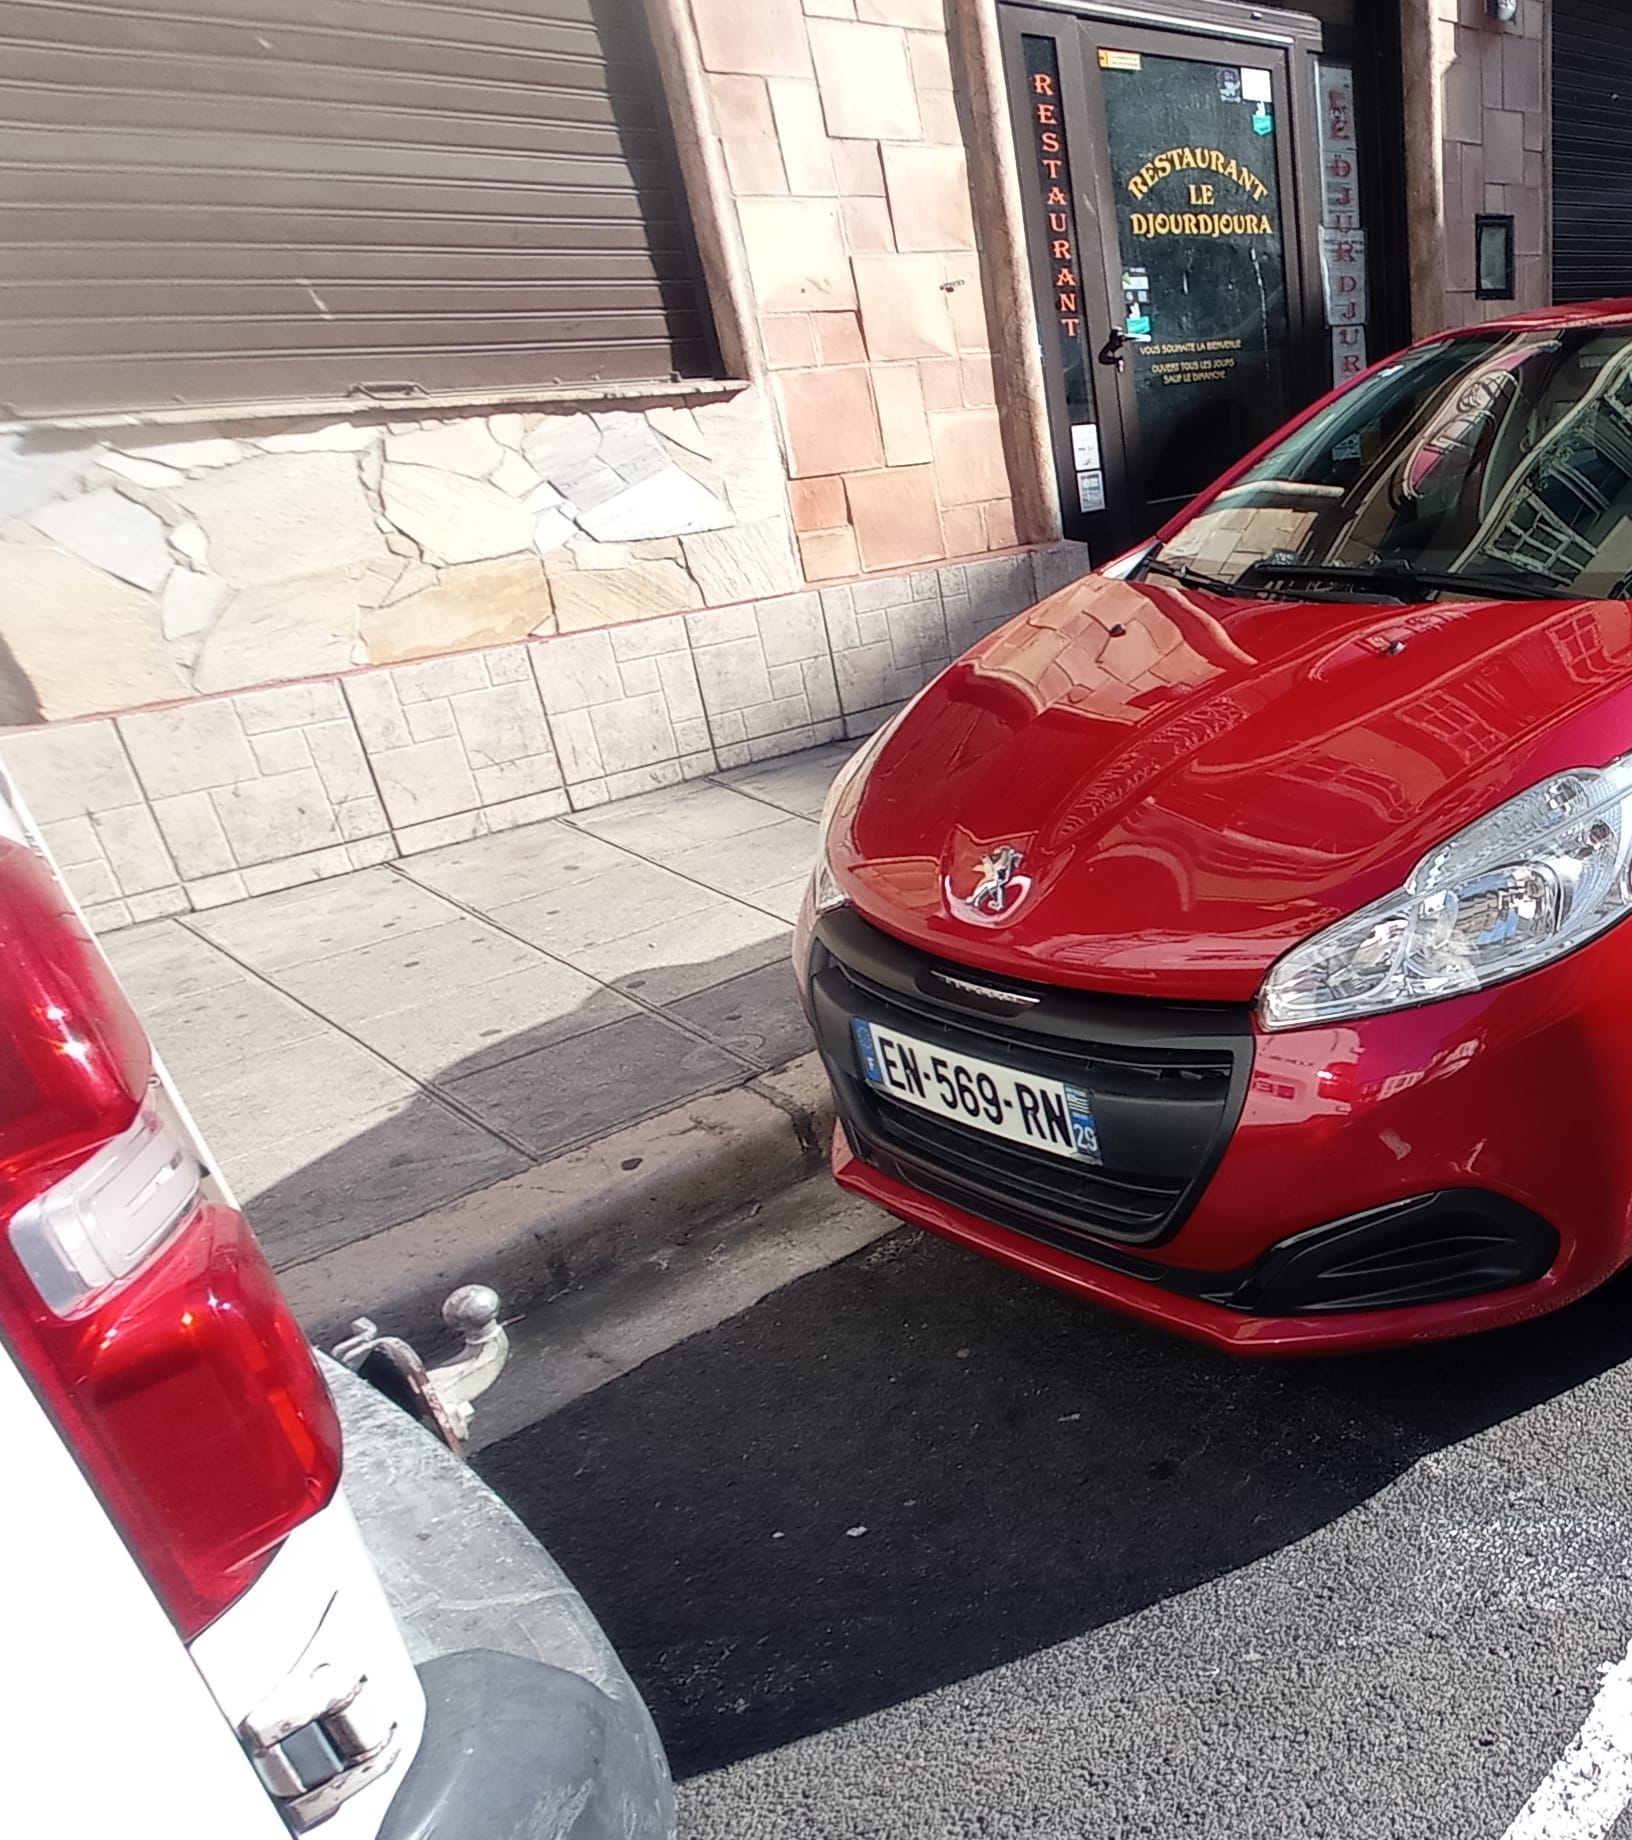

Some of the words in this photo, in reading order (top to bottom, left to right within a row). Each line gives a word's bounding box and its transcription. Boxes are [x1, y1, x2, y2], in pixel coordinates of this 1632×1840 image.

[1128, 147, 1268, 201] RESTAURANT
[1033, 73, 1080, 337] RESTAURANT
[1188, 184, 1215, 206] LE
[1130, 213, 1273, 238] DJOURDJOURA
[1140, 343, 1160, 356] VOUS
[1161, 341, 1196, 354] SOUHAITE
[1196, 342, 1206, 352] LA
[1151, 362, 1180, 374] OUVERT
[1181, 361, 1199, 371] TOUS
[1200, 359, 1212, 369] LES
[1183, 372, 1192, 383] LE
[878, 1036, 1073, 1148] EN-569-RN
[1073, 1123, 1098, 1152] 29
